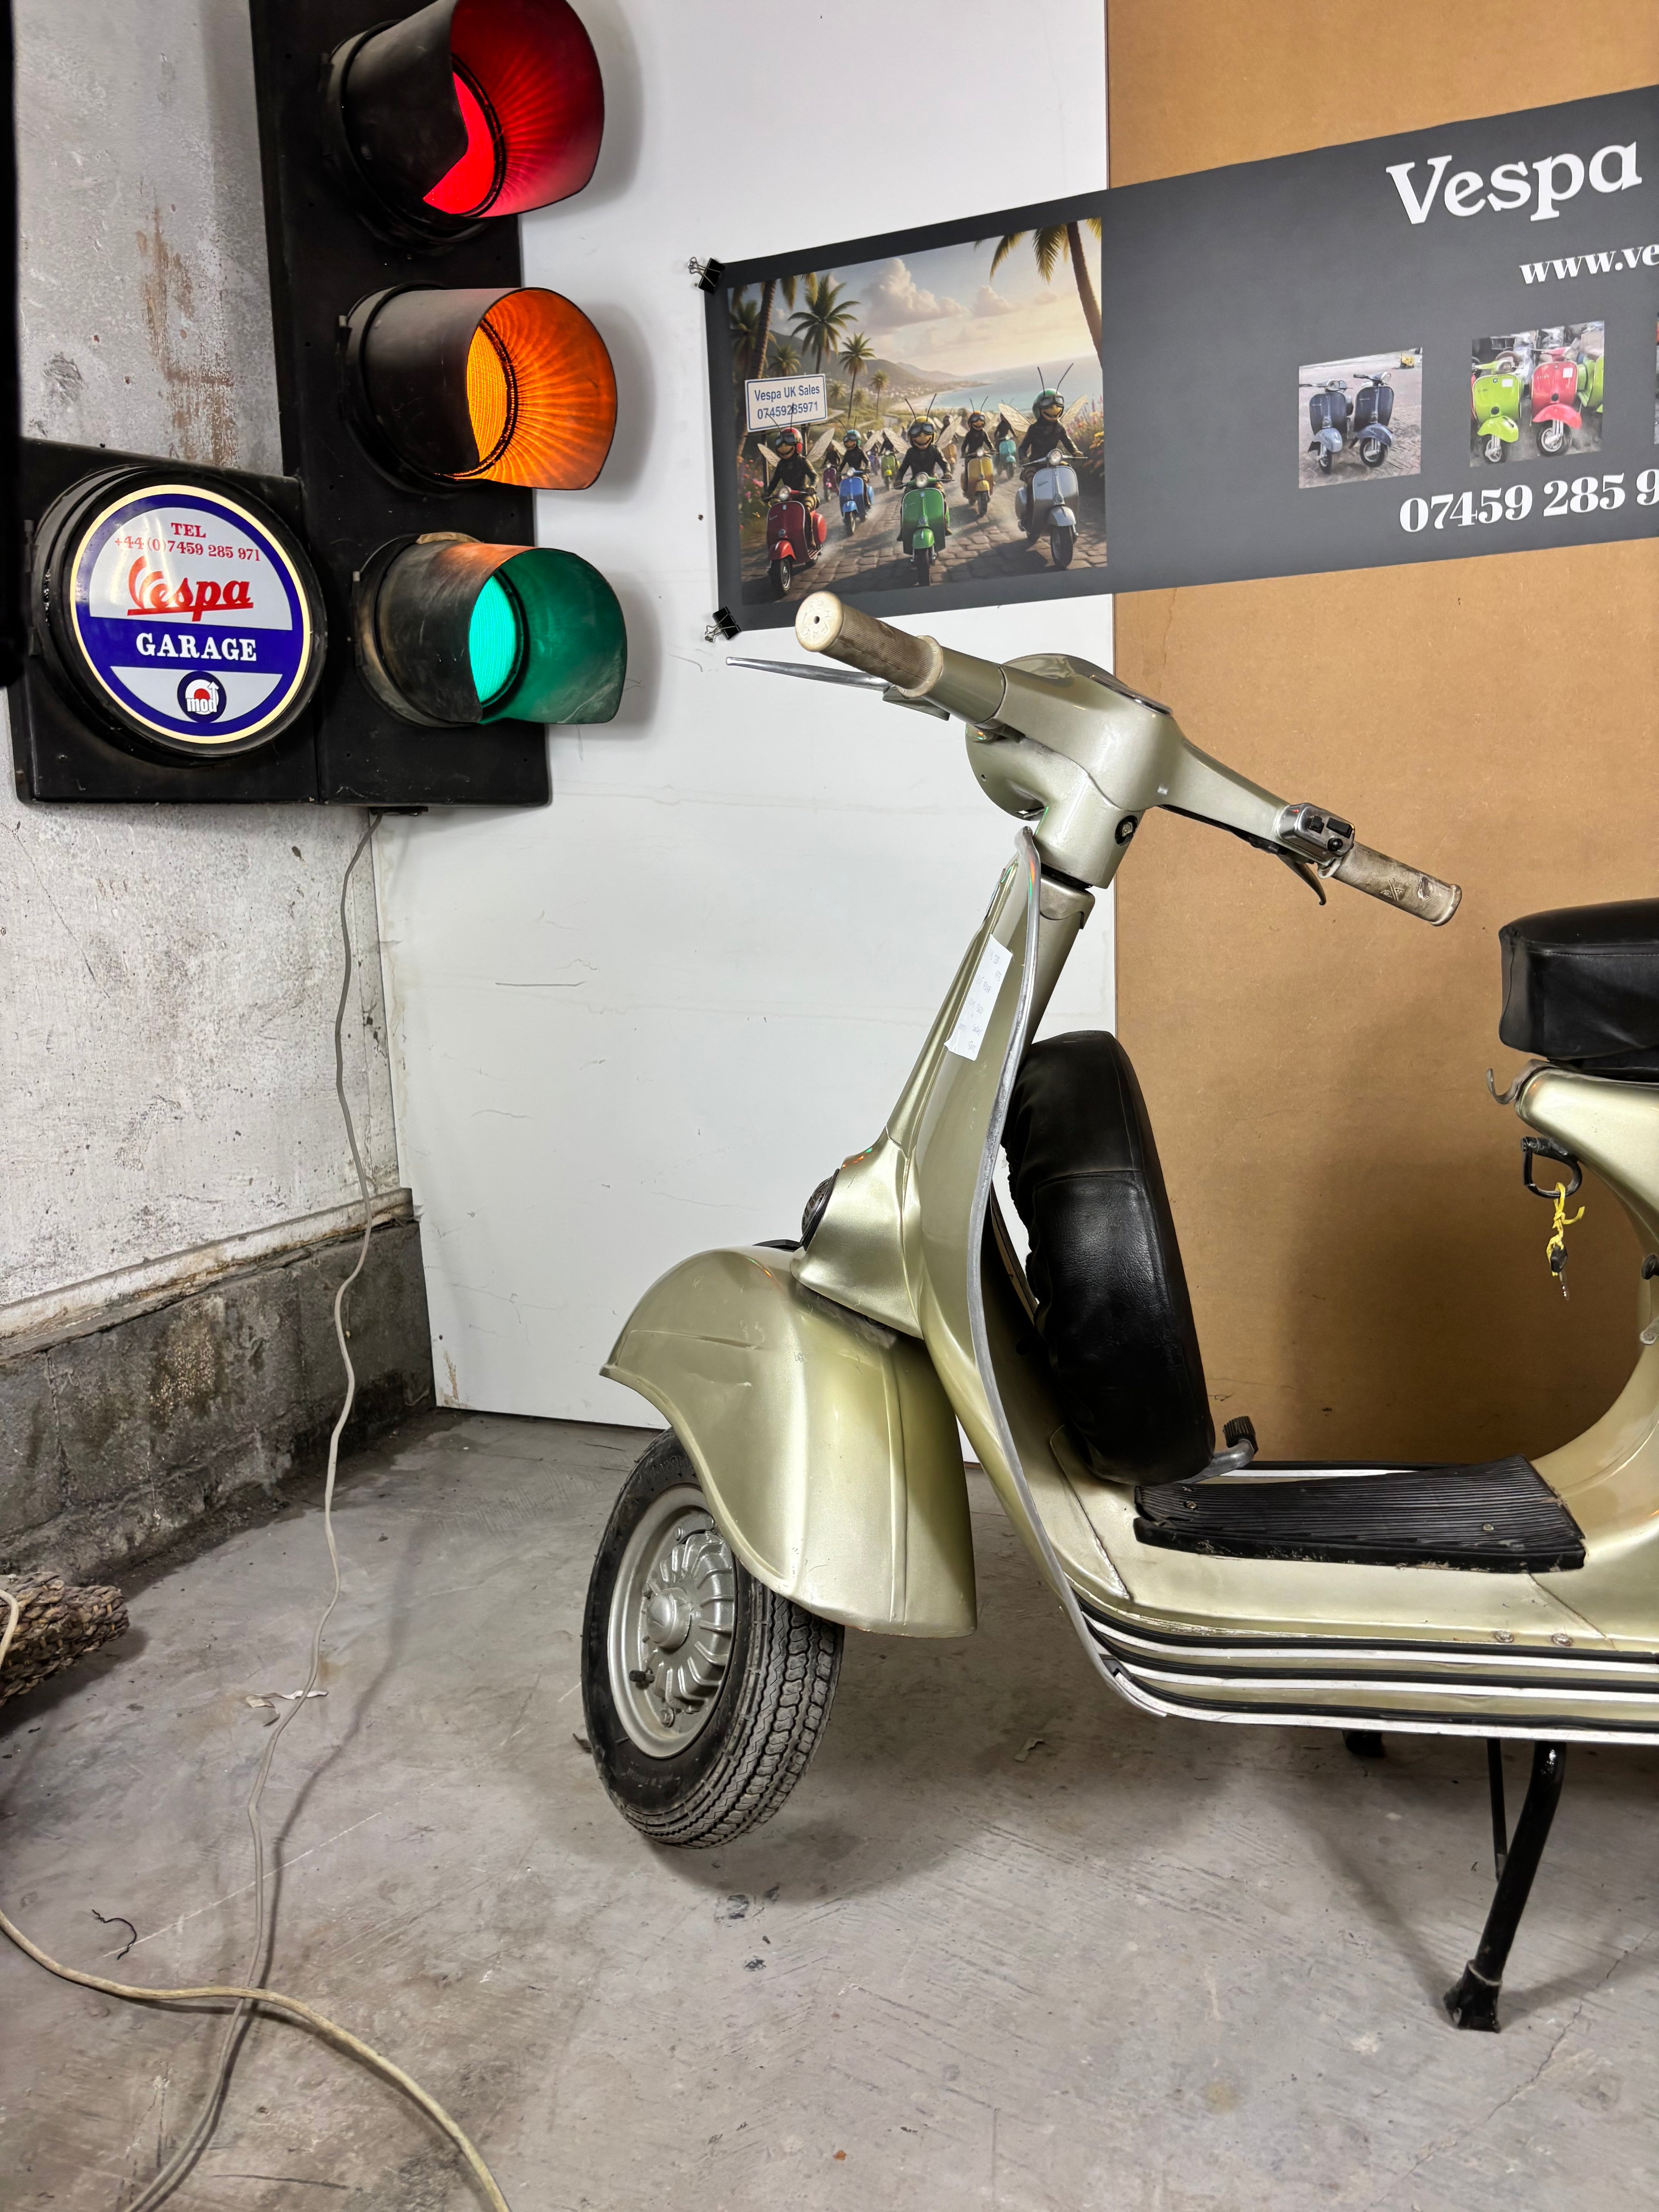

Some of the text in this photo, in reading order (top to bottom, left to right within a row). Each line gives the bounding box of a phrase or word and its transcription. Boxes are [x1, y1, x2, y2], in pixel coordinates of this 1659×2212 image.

[1386, 141, 1642, 225] Vespa
[754, 384, 820, 402] Vespa UK Sales
[757, 401, 818, 420] 07459285971
[1399, 484, 1533, 532] 07459
[1543, 472, 1626, 517] 285
[170, 522, 206, 538] TEL
[208, 545, 234, 559] 285
[238, 548, 261, 561] 971
[127, 555, 254, 622] Vespa
[136, 632, 257, 662] GARAGE
[186, 681, 219, 713] mod
